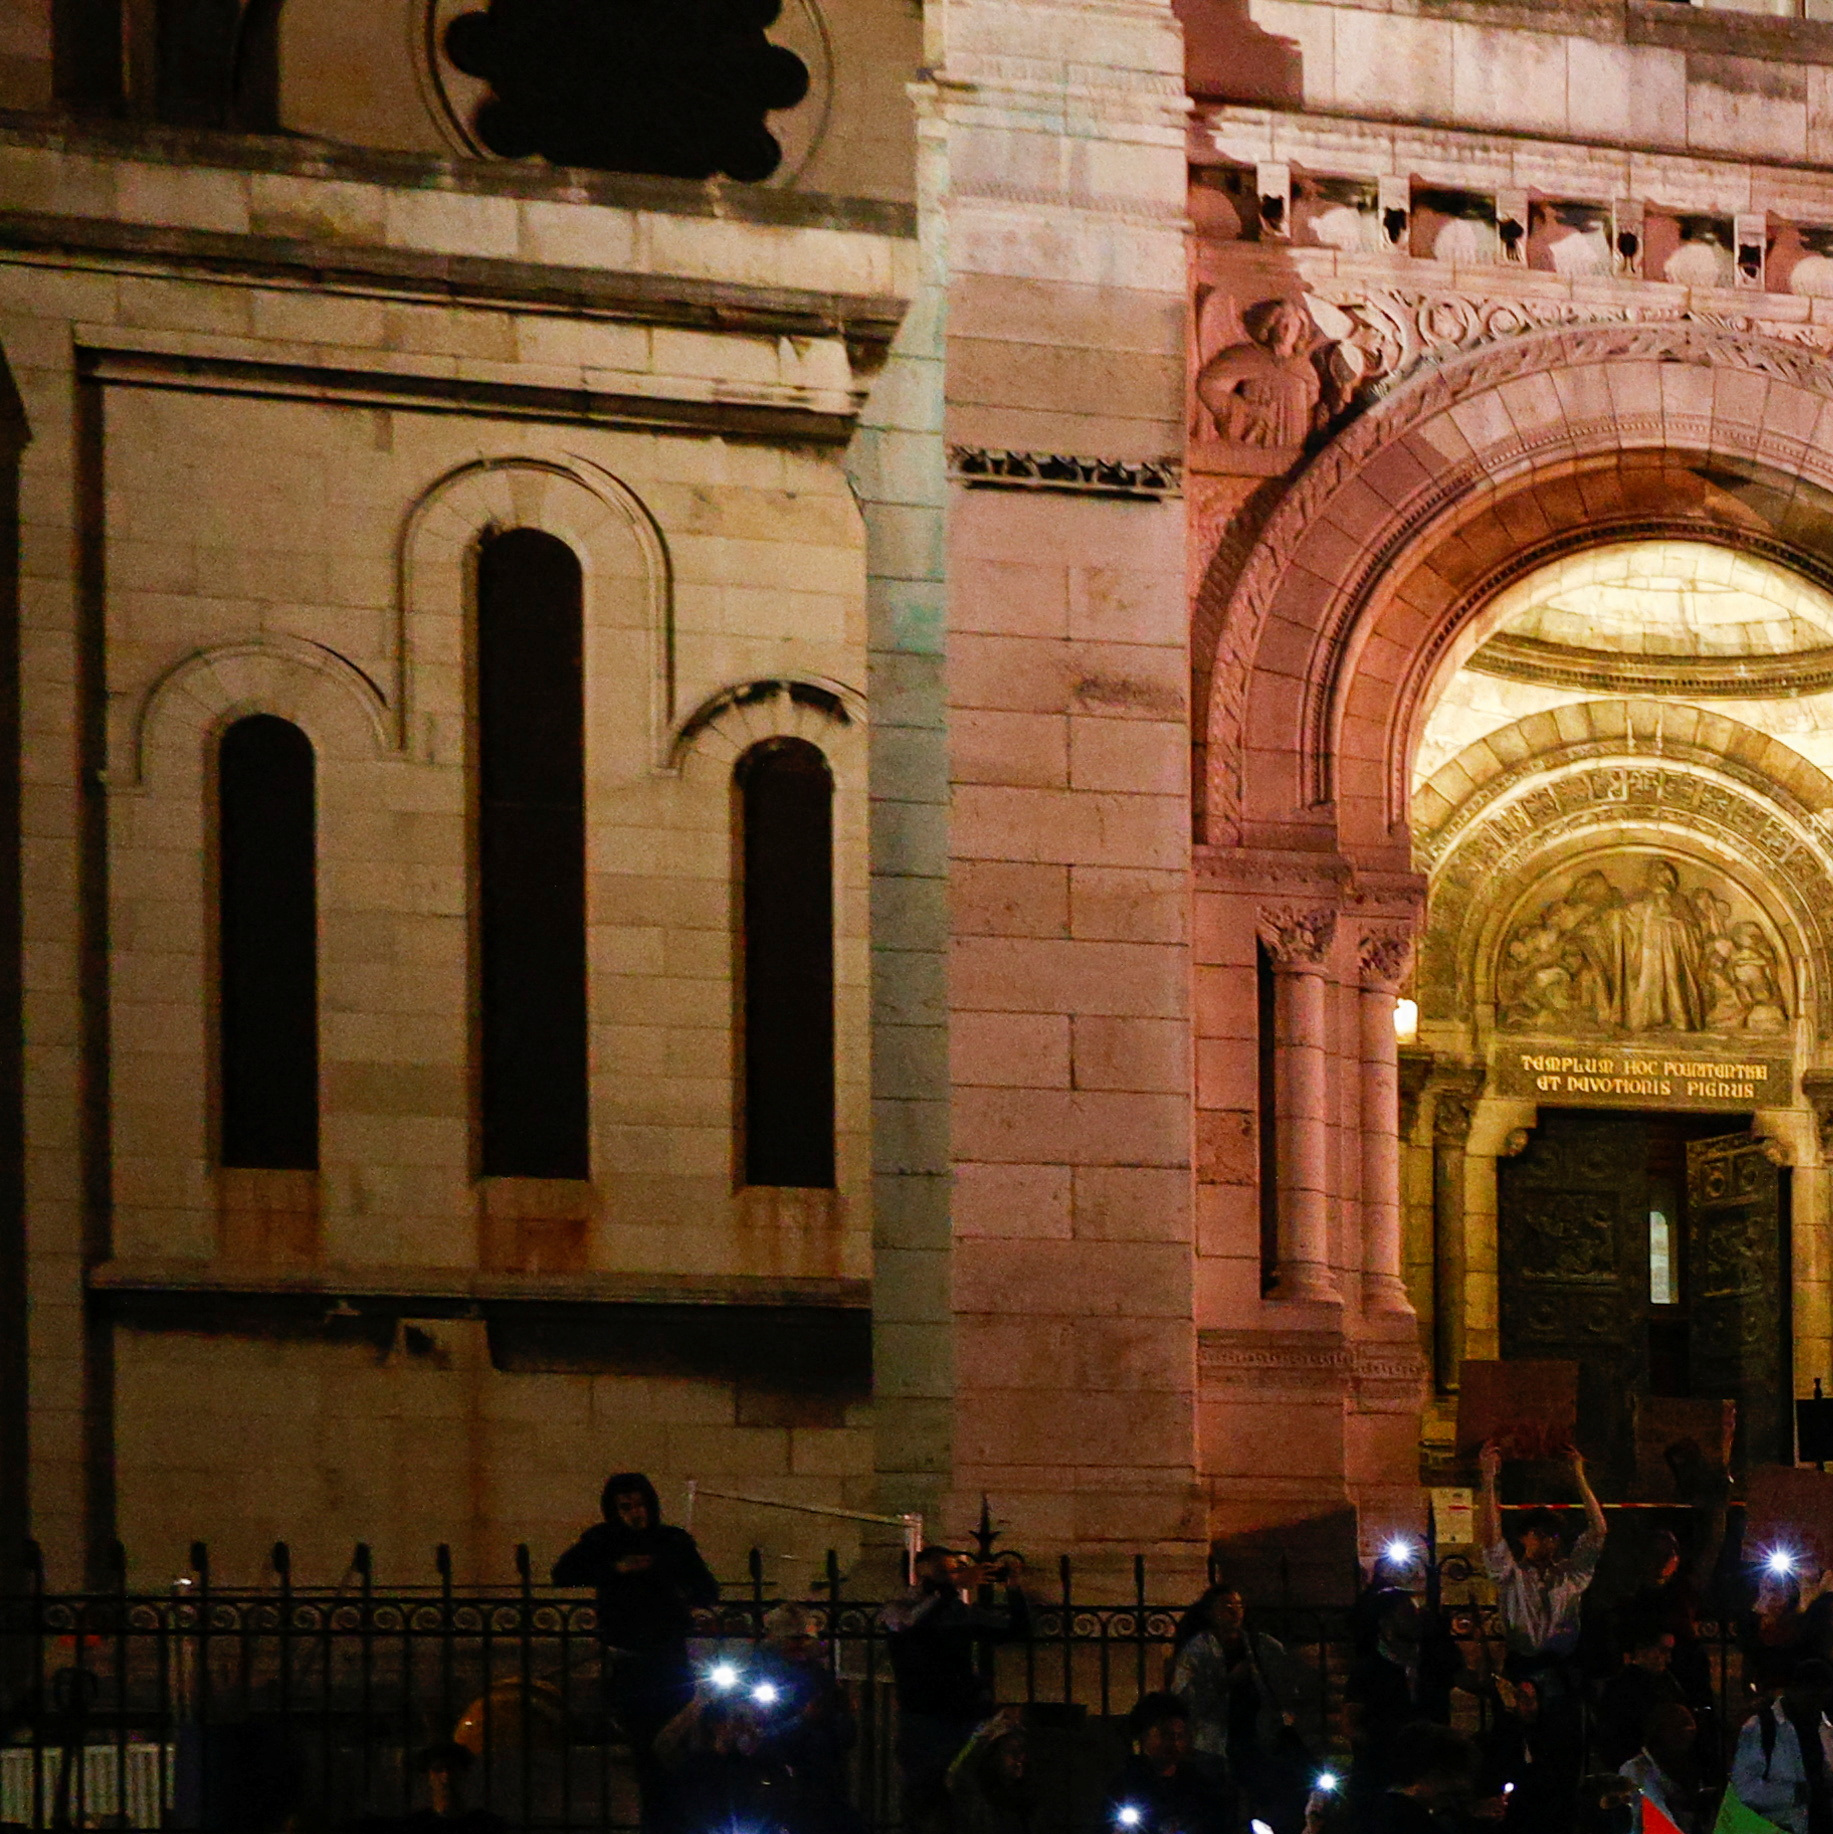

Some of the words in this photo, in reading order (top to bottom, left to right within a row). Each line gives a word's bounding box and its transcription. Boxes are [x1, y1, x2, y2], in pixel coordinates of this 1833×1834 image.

[1521, 1054, 1614, 1075] TEMPLUM
[1623, 1059, 1658, 1077] HOC
[1536, 1075, 1562, 1092] ET
[1567, 1076, 1671, 1096] DEVOTIONIS
[1687, 1080, 1754, 1099] PIGNUS
